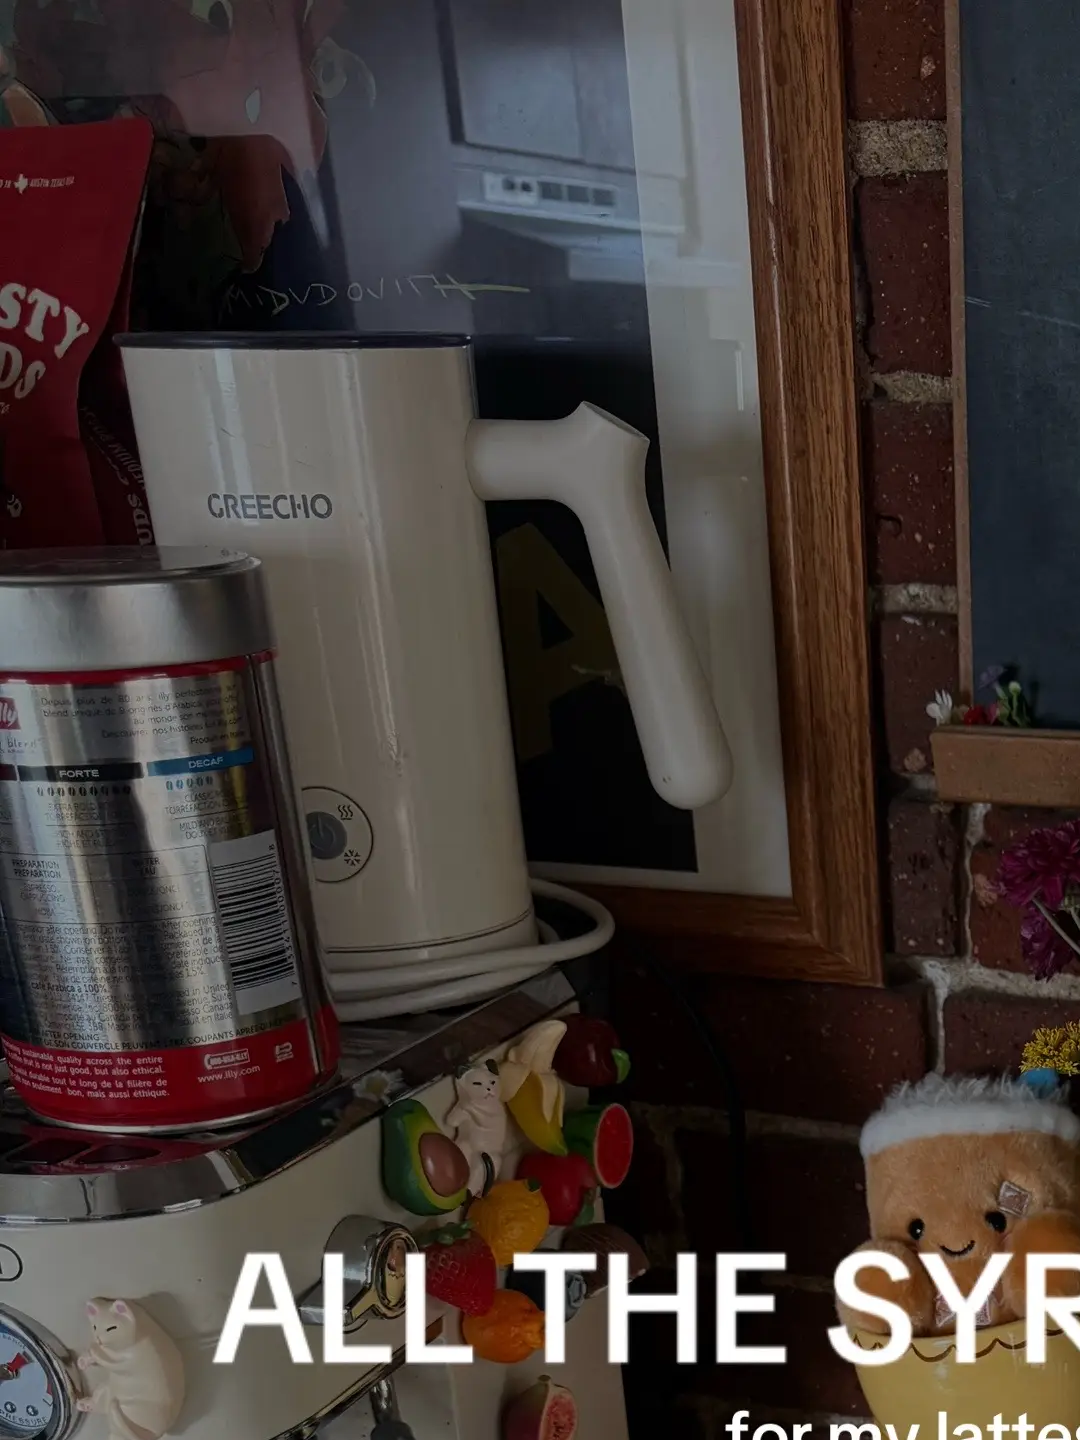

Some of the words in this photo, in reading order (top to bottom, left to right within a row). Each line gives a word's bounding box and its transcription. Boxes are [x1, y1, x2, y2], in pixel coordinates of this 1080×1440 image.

[0, 282, 90, 360] STY
[207, 493, 333, 519] GREECHO
[187, 756, 224, 769] DECAF
[59, 769, 100, 778] FORTE
[63, 1031, 100, 1041] OPENING
[71, 1041, 120, 1051] COUVERCLE
[188, 1030, 234, 1045] COUPANTS
[57, 1055, 82, 1067] quality
[85, 1057, 113, 1066] across
[116, 1056, 132, 1066] the
[136, 1055, 163, 1065] entire
[54, 1063, 68, 1075] just
[69, 1066, 93, 1076] good,
[94, 1065, 109, 1076] but
[111, 1067, 130, 1076] also
[79, 1079, 98, 1091] long
[100, 1079, 112, 1088] de
[114, 1079, 124, 1088] la
[126, 1077, 152, 1088] filière
[155, 1077, 168, 1087] de
[66, 1086, 85, 1098] bon,
[87, 1089, 106, 1099] mais
[108, 1089, 130, 1099] aussi
